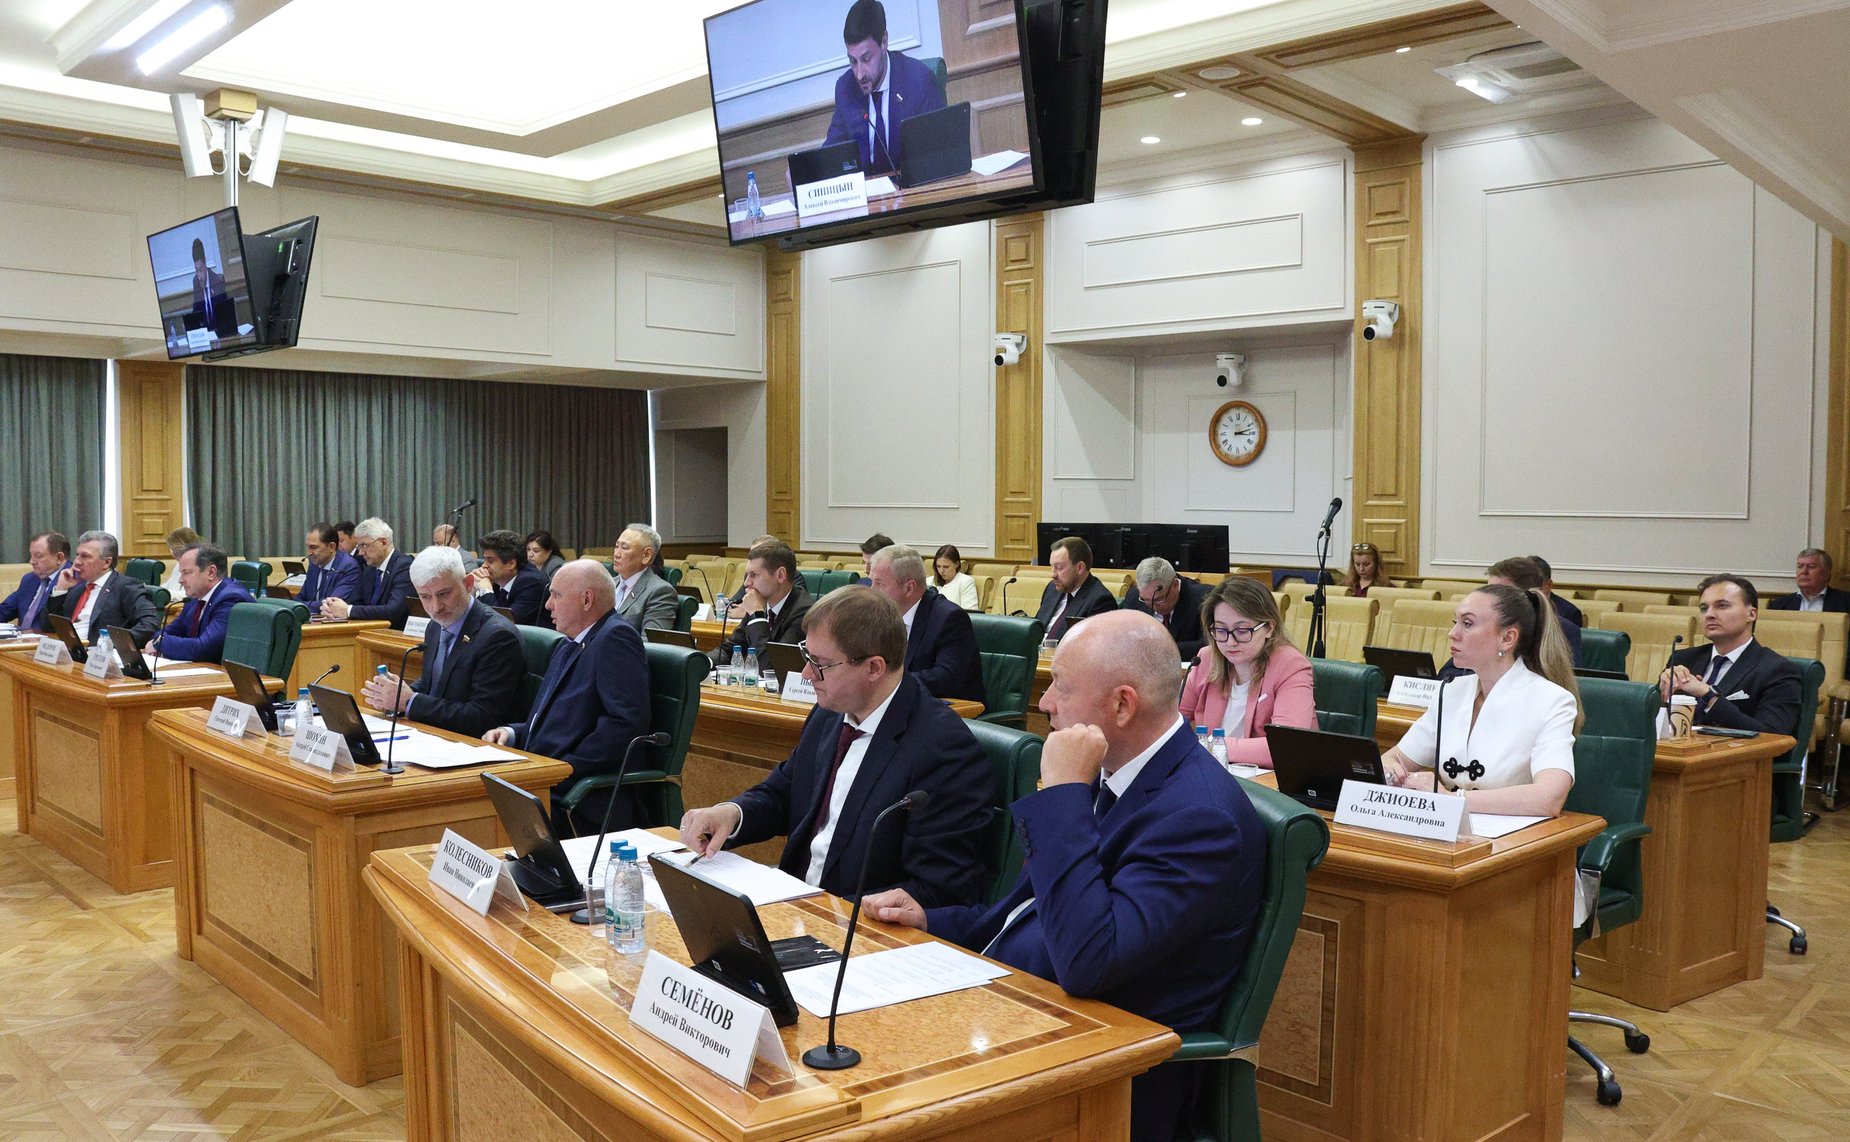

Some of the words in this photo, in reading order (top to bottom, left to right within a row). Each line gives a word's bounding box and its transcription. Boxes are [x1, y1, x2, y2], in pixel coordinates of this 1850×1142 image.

[808, 182, 853, 198] СИНИЦЫН
[1363, 789, 1436, 812] ДЖИОЕВА
[1350, 804, 1376, 816] Ольга
[1380, 809, 1445, 827] Александровна
[442, 861, 454, 876] Иван
[443, 839, 494, 878] КОЛЕСНИКОВ
[661, 976, 734, 1031] СЕМЁНОВ
[649, 1001, 679, 1027] Андрей
[679, 1017, 731, 1058] Викторович
